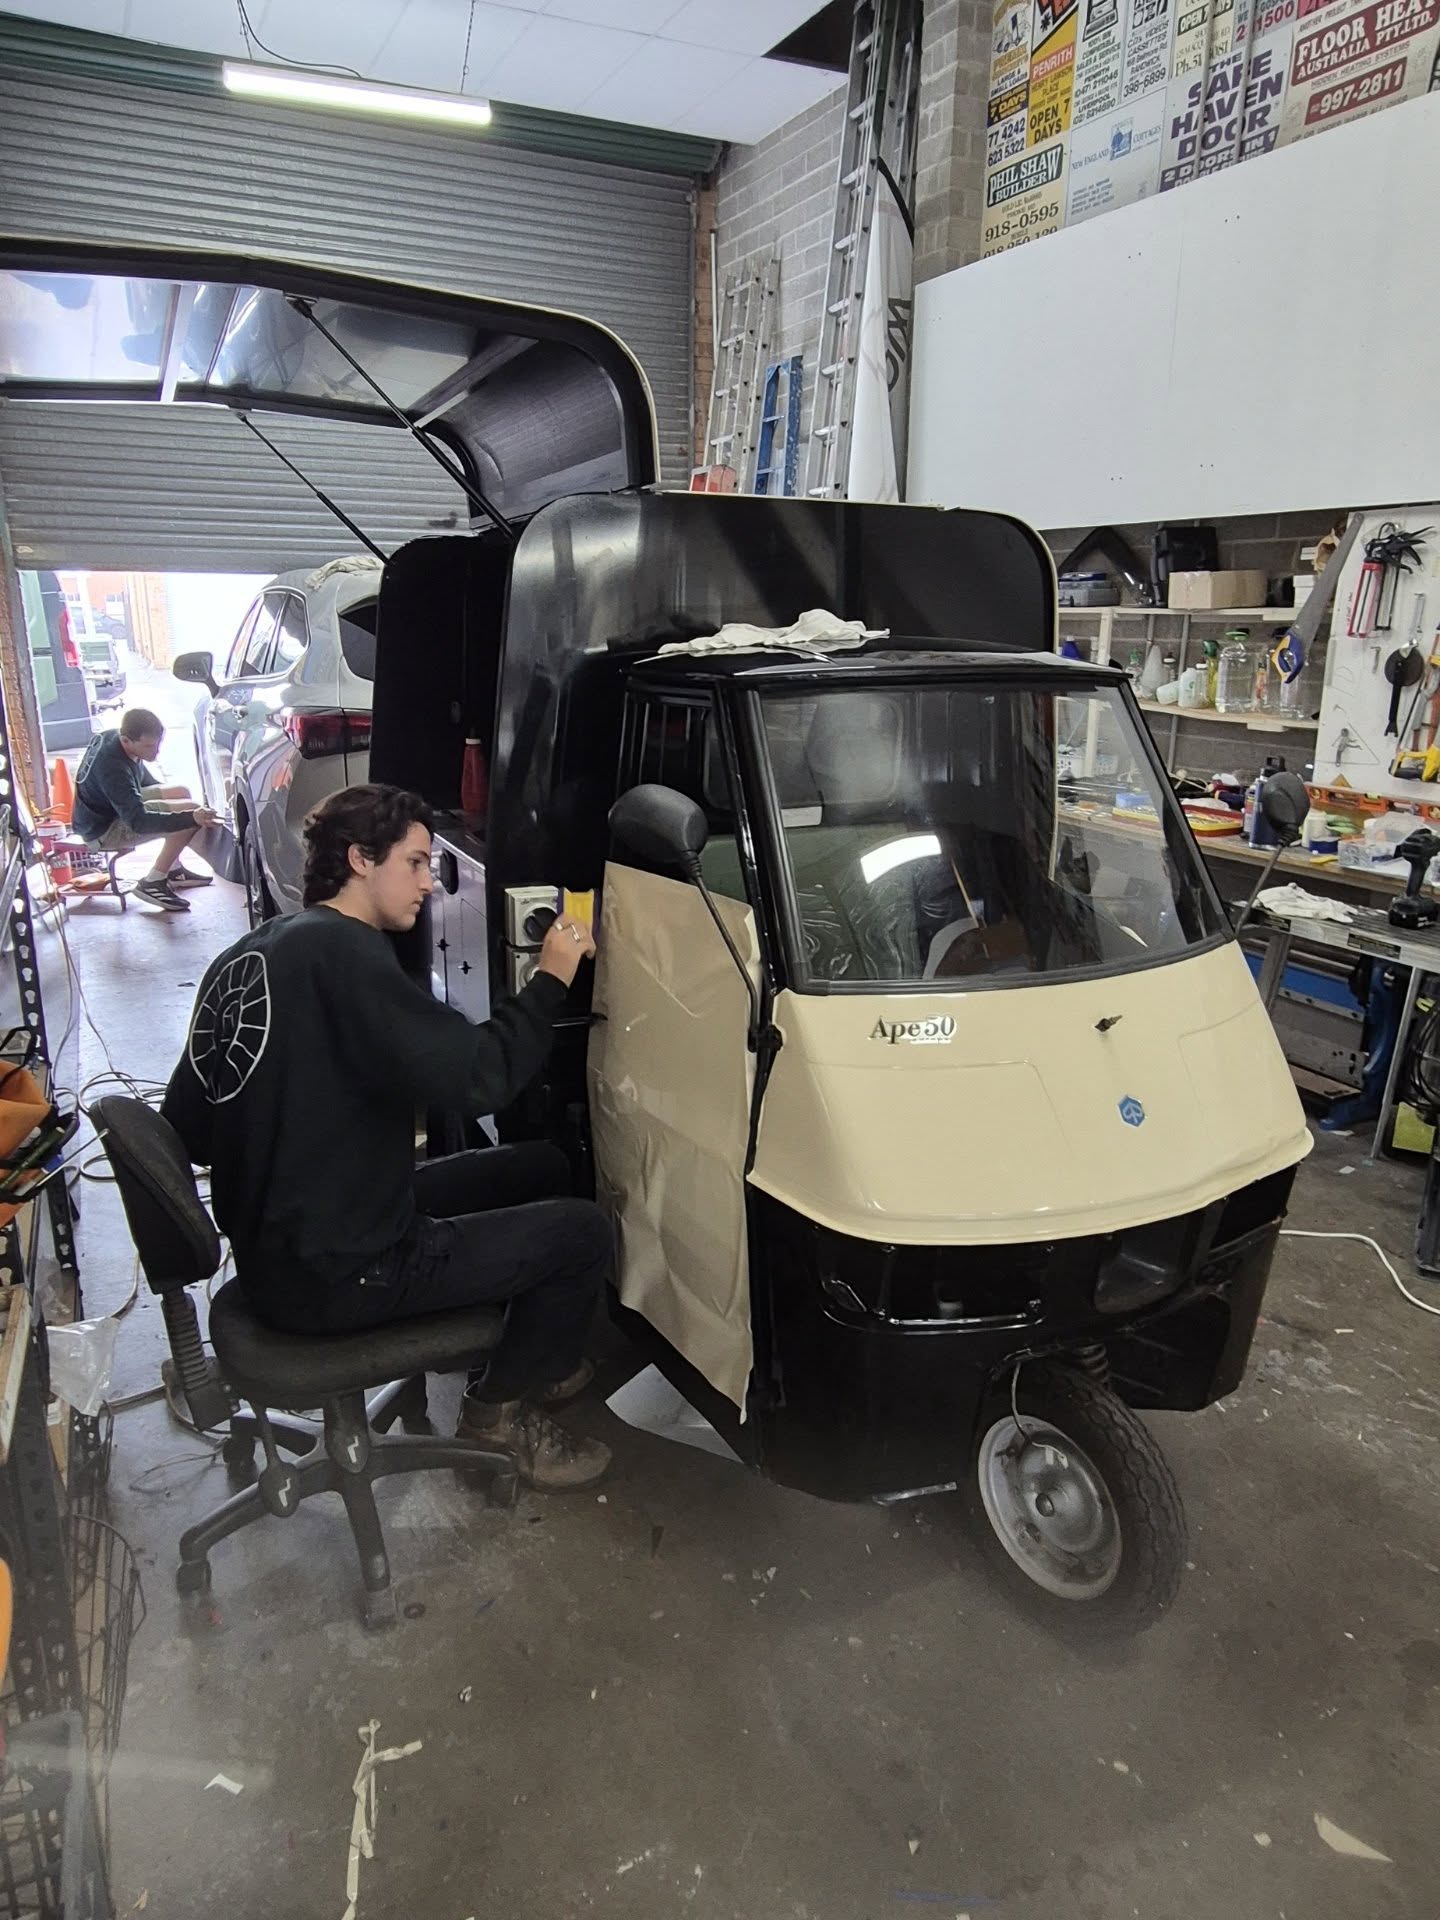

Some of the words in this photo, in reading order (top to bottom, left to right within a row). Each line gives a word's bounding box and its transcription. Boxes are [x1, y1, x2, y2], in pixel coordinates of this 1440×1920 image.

[1127, 30, 1167, 58] CASSETTES
[1296, 16, 1366, 66] FLOOR
[1375, 40, 1410, 63] SYSTEMS
[1032, 45, 1073, 79] PENRITH
[1208, 51, 1242, 73] THE
[1297, 37, 1371, 80] AUSTRALIA
[1188, 49, 1273, 108] SAFE
[999, 91, 1027, 113] DAYS
[1029, 103, 1059, 130] OPEN
[1063, 97, 1071, 114] 7
[1171, 70, 1284, 139] HAVEN
[1001, 117, 1025, 141] 4242
[1034, 118, 1062, 144] DAYS
[1084, 148, 1110, 166] ENGLAND
[1133, 124, 1161, 143] COTTAGES
[1178, 103, 1271, 161] DOOR
[988, 149, 1003, 168] 623
[1164, 169, 1175, 183] 2
[1244, 135, 1265, 153] IN
[1267, 129, 1276, 143] 1
[988, 164, 1020, 207] PHIL
[1020, 145, 1062, 182] SHAW
[995, 171, 1050, 204] BUILDER
[985, 201, 1059, 243] 918-0595
